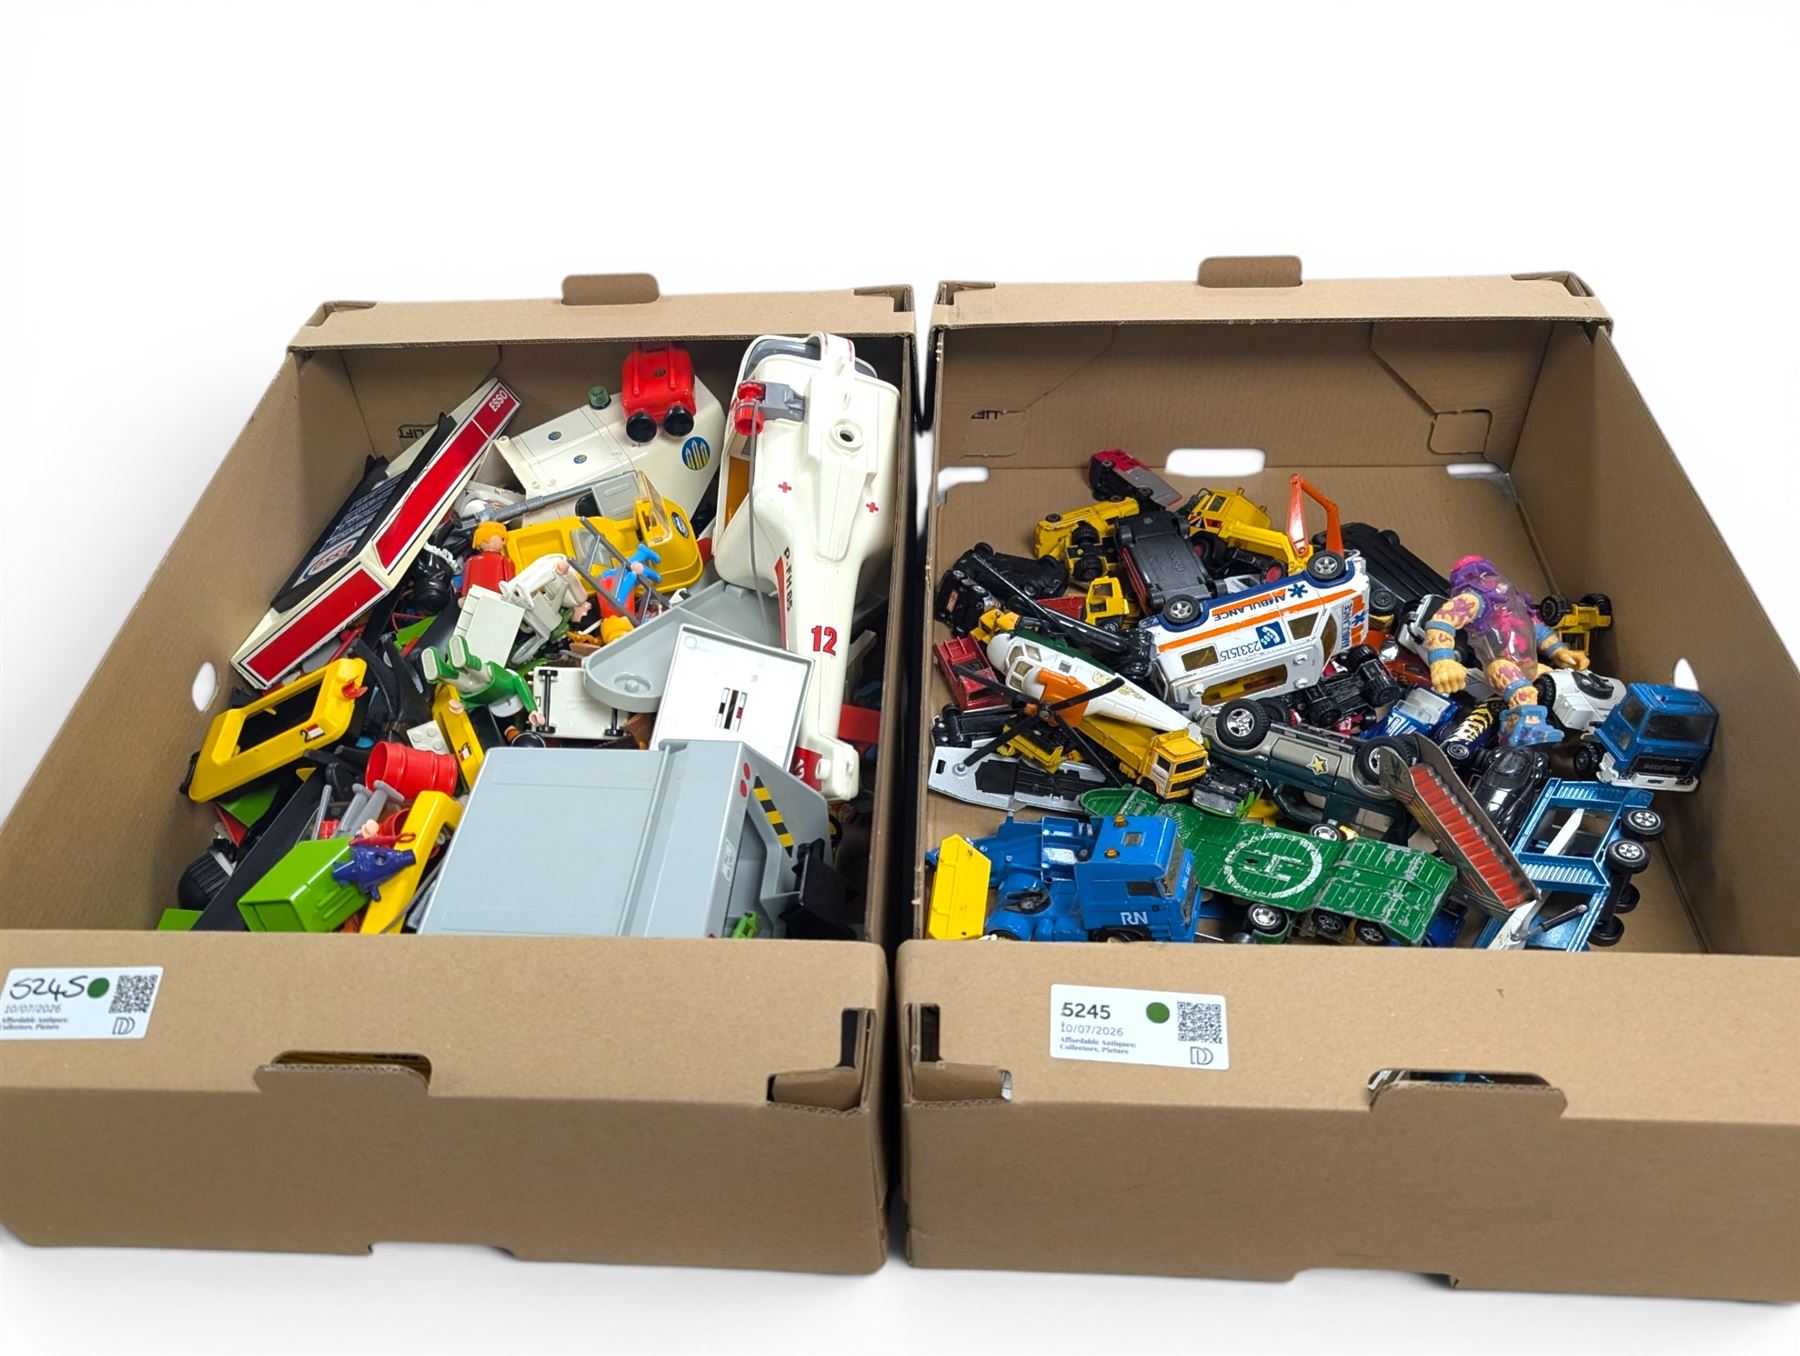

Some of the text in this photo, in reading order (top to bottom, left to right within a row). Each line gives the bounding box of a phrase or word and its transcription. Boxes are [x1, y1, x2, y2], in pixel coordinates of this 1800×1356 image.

[488, 390, 509, 412] ESSO
[1213, 594, 1287, 622] AMBULANCE
[810, 625, 838, 657] 12
[1121, 911, 1148, 925] RN
[5, 1004, 62, 1014] 10/07/2026
[1060, 1002, 1111, 1020] 5245
[1060, 1021, 1124, 1037] 10/07/2026
[1060, 1037, 1099, 1046] Affordable
[1102, 1047, 1129, 1055] Picture
